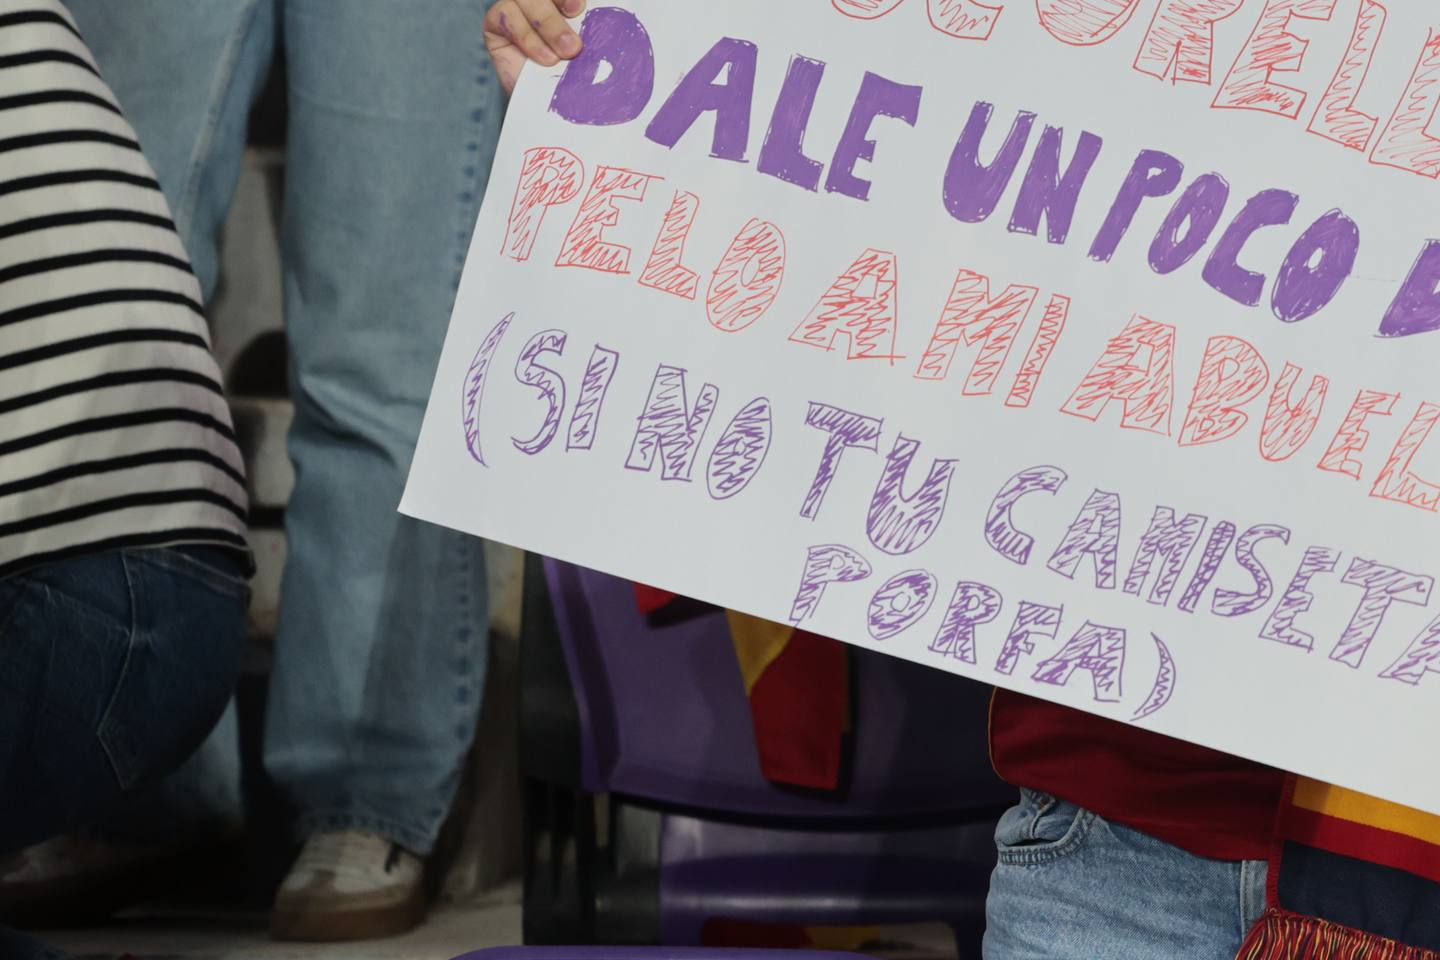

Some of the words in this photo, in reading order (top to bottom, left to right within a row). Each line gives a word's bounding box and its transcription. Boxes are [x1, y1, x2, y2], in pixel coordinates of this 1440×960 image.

[500, 146, 786, 332] PELO
[787, 248, 906, 366] A
[913, 268, 1071, 408] MI
[548, 5, 923, 201] DALE
[942, 100, 1103, 245] UN
[1088, 148, 1361, 324] POCO
[462, 311, 620, 468] (SI
[624, 363, 774, 500] NO
[799, 400, 960, 556] TU
